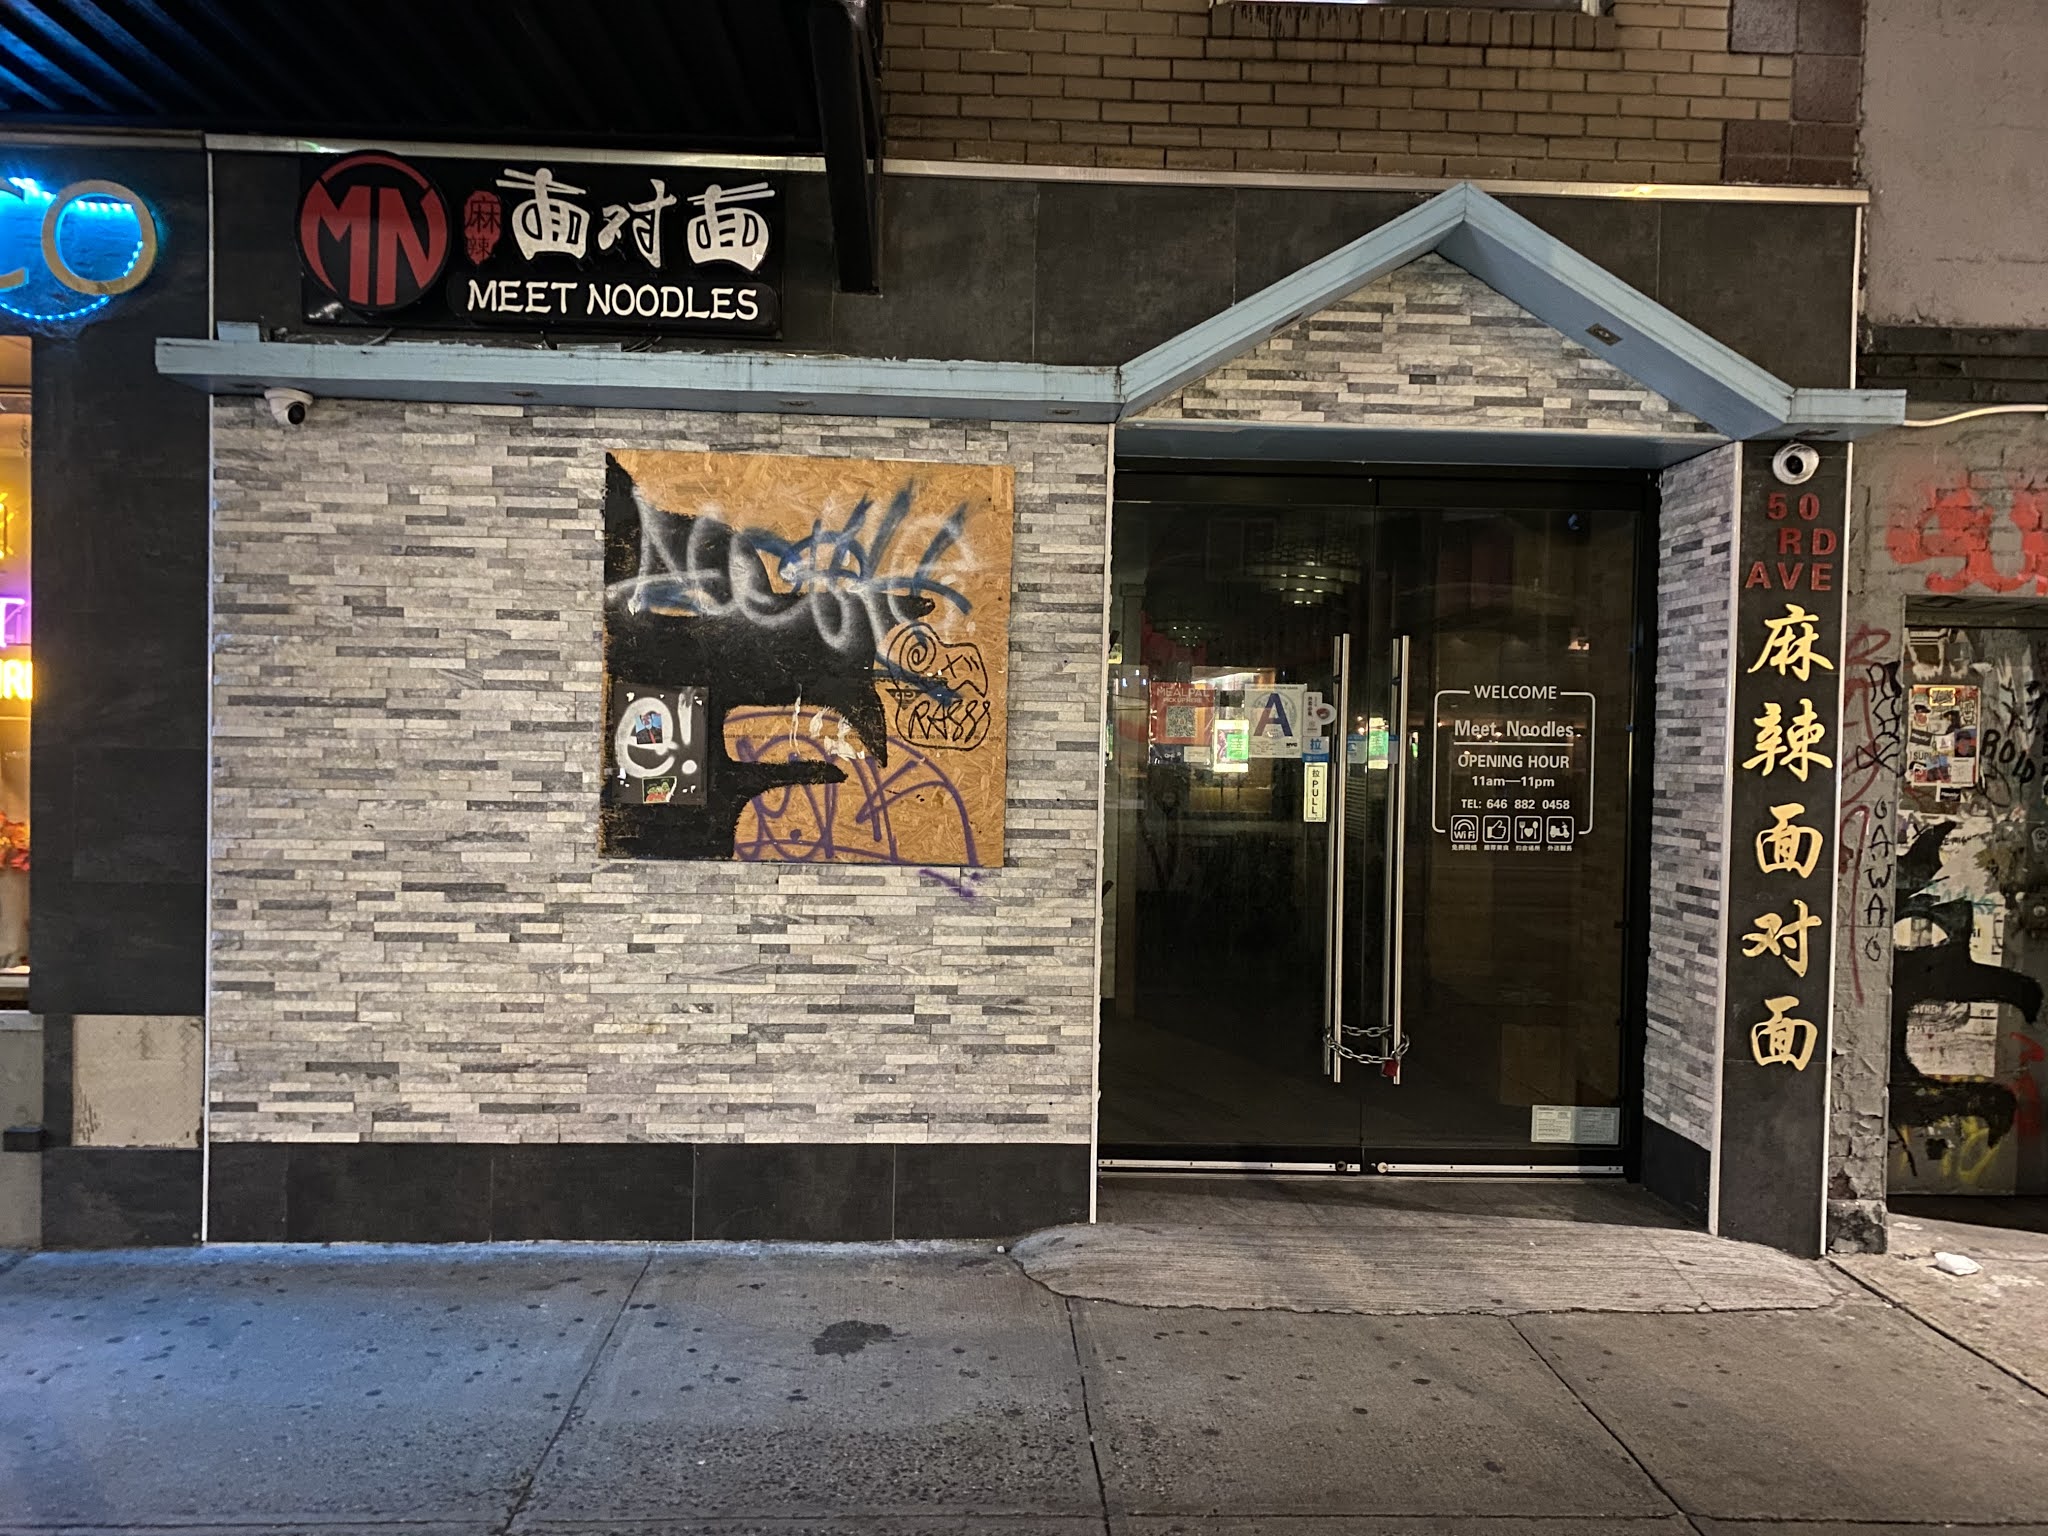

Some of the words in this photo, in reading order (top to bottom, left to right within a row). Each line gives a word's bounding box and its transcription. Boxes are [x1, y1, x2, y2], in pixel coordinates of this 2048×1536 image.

[496, 167, 776, 273] 面对面
[300, 180, 448, 307] MN
[467, 278, 578, 315] MEET
[587, 282, 759, 322] NOODLES
[1766, 491, 1821, 522] 50
[1778, 527, 1838, 556] RD
[1744, 560, 1834, 592] AVE
[1156, 687, 1211, 698] MEALPAL
[1474, 685, 1557, 699] WELCOME
[1253, 692, 1293, 737] A
[1454, 720, 1496, 737] Meet
[1507, 720, 1574, 738] Noodles
[1458, 754, 1523, 769] OPENING
[1528, 755, 1570, 769] HOUR
[1311, 779, 1320, 815] PULL
[1461, 798, 1482, 809] TEL:
[1486, 798, 1508, 810] 646
[1514, 799, 1536, 810] 882
[1542, 799, 1571, 810] 0458
[1742, 603, 1834, 1073] 麻辣面对面
